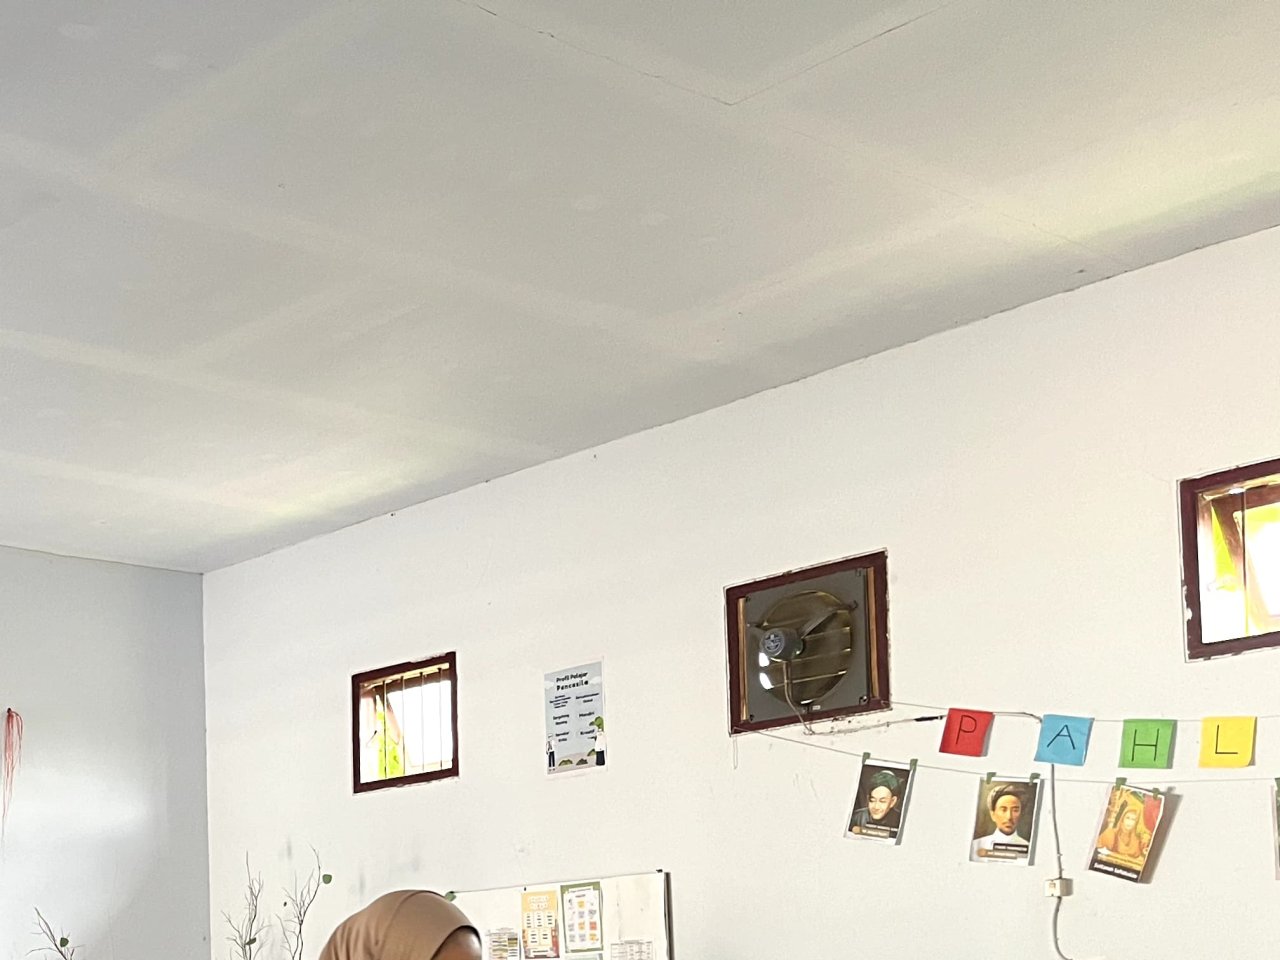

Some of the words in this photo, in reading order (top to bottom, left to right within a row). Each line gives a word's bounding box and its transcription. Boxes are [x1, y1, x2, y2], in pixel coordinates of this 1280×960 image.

[556, 680, 589, 691] Pancasila
[955, 714, 977, 745] P
[1046, 724, 1076, 750] A
[1215, 724, 1238, 754] L
[1131, 728, 1160, 762] H
